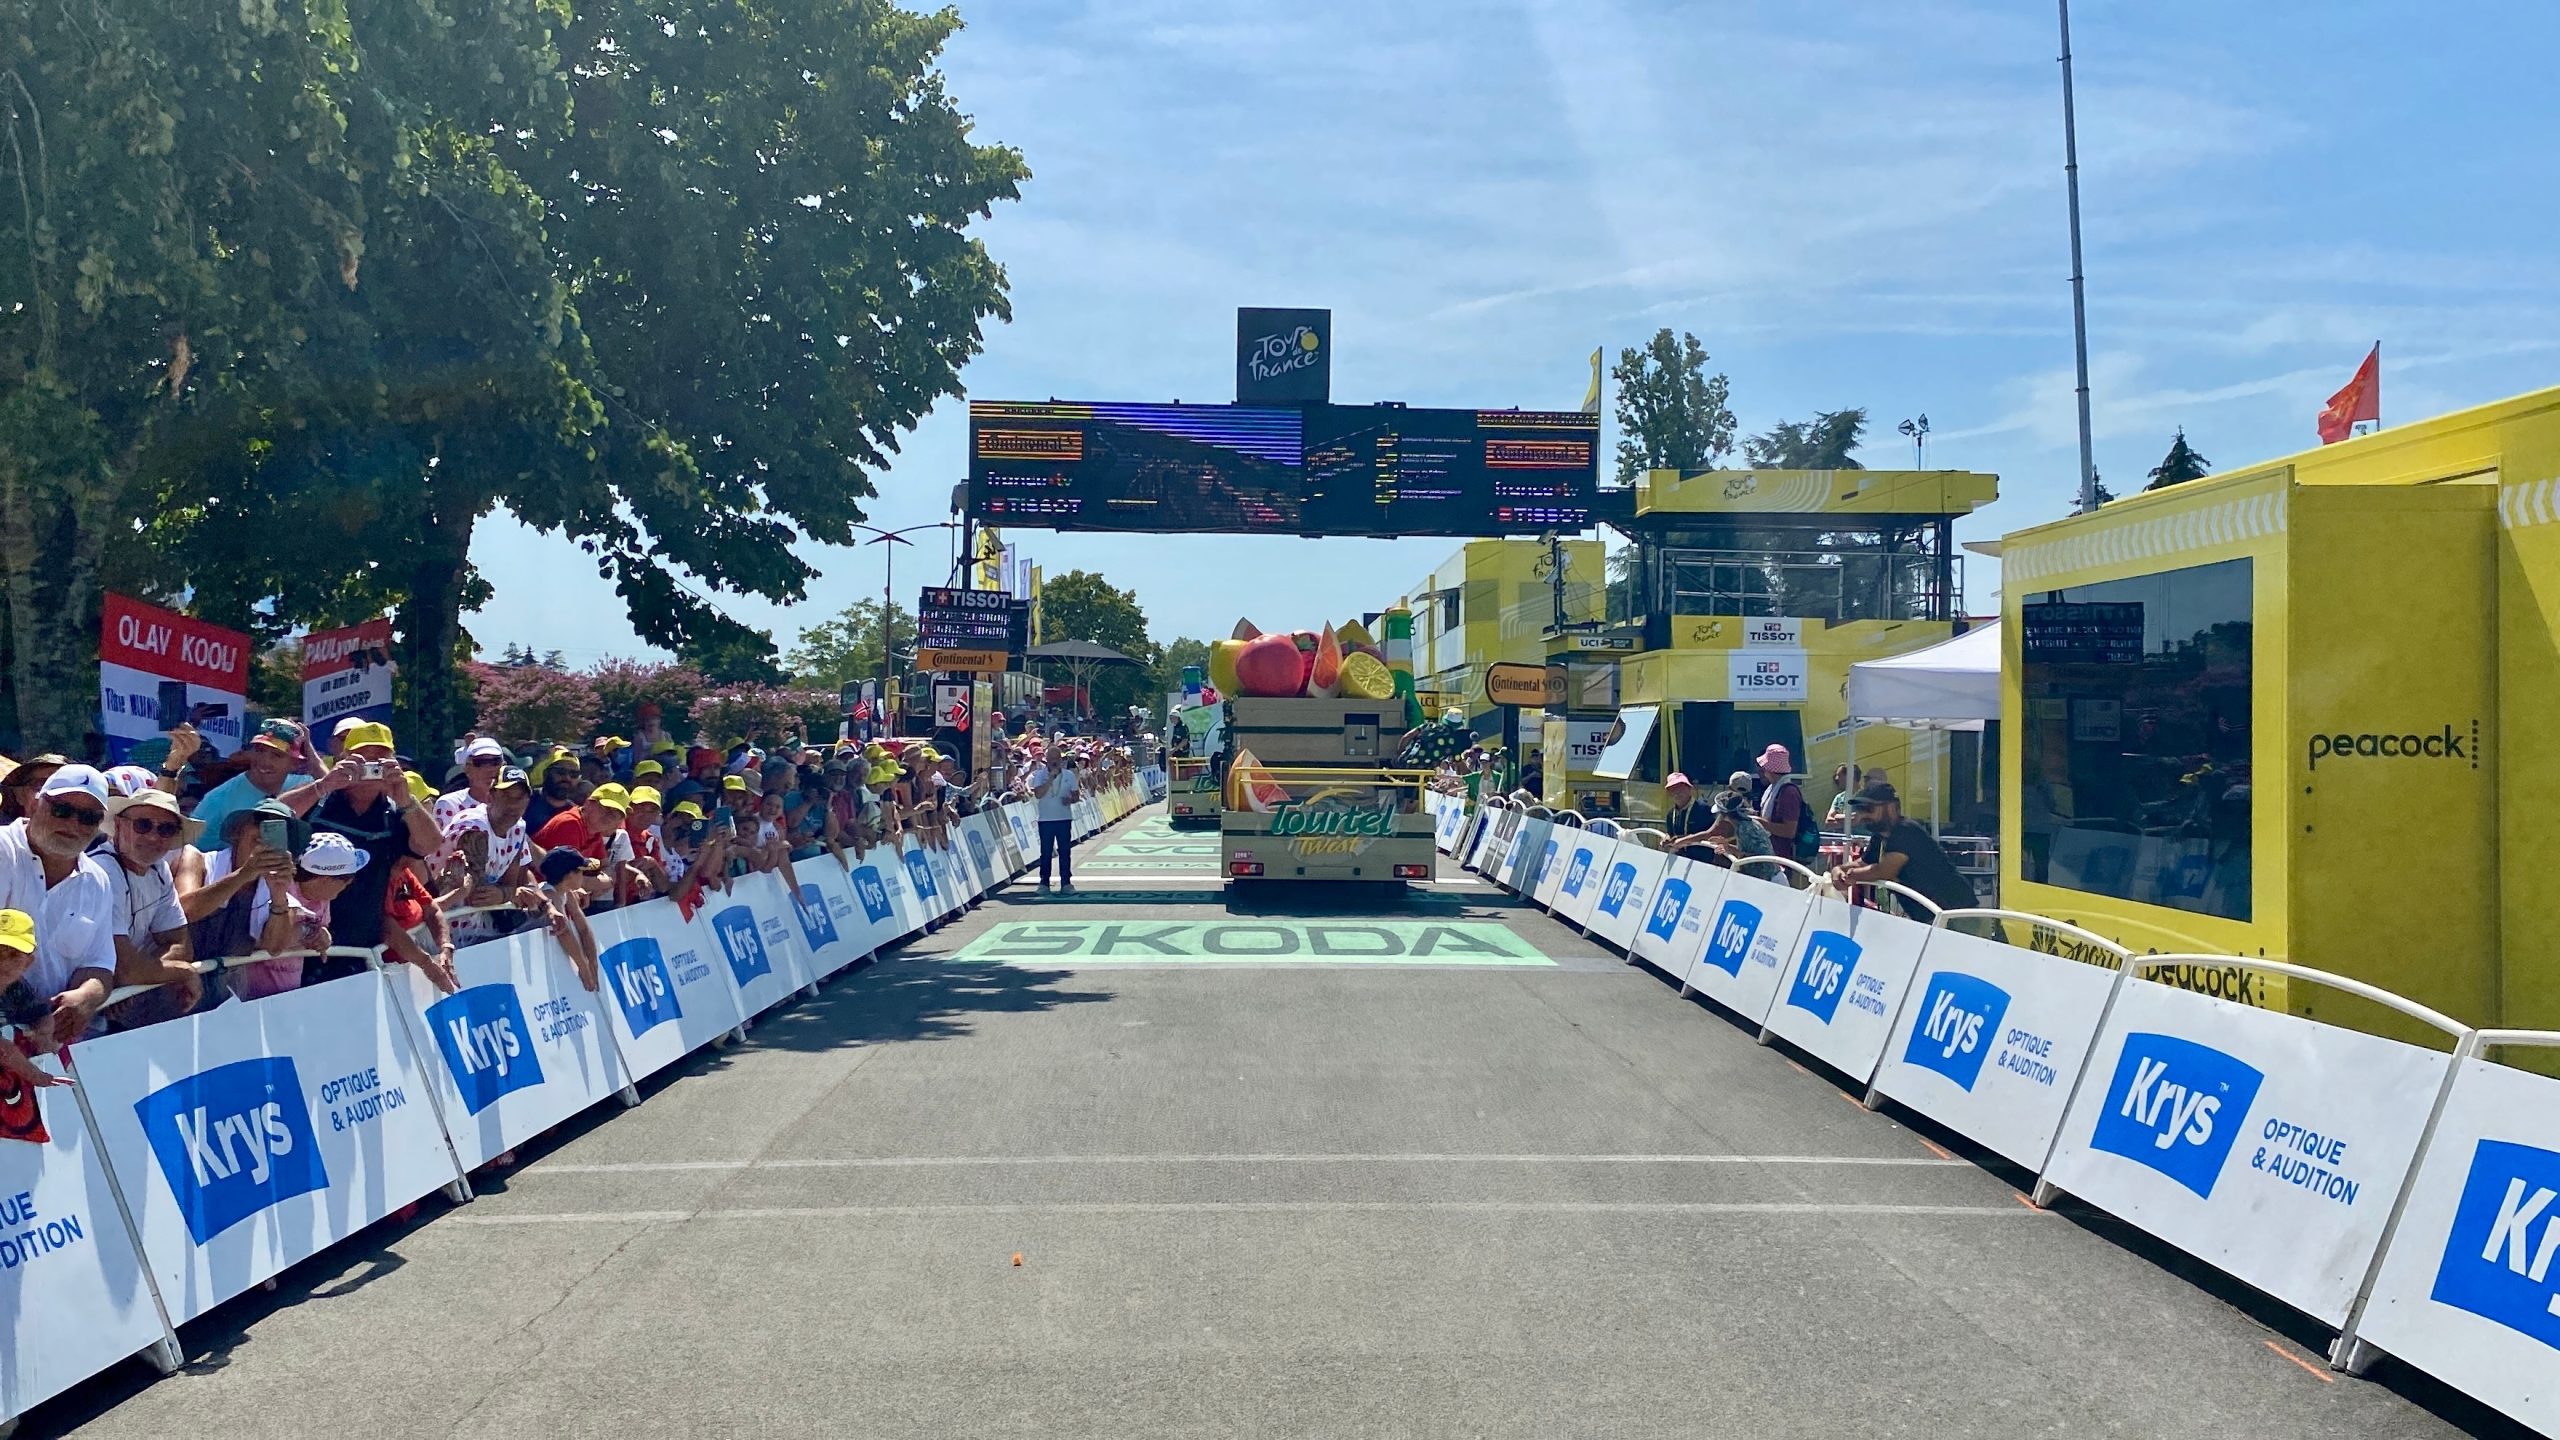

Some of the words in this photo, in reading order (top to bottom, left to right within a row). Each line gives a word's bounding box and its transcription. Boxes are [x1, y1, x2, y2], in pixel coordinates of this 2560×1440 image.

[950, 592, 1011, 609] TISSOT
[119, 615, 172, 656] OLAV
[1580, 639, 1599, 647] UCI
[1749, 632, 1795, 641] TISSOT
[932, 652, 986, 668] Continental
[1491, 675, 1540, 692] Continental
[1737, 675, 1799, 686] TISSOT
[2309, 724, 2466, 771] peacock
[1271, 799, 1396, 836] Tourtel
[1297, 836, 1363, 856] Twist
[858, 878, 884, 911] Krys
[1607, 871, 1627, 906] Krys
[1656, 889, 1681, 928] Krys
[723, 924, 758, 966] Krys
[1716, 912, 1749, 959] Krys
[615, 961, 665, 1011] Krys
[1802, 944, 1843, 1000] Krys
[1856, 973, 1885, 996] OPTIQUE
[533, 996, 571, 1022] OPTIQUE
[1856, 993, 1887, 1017] AUDITION
[1923, 989, 1984, 1059] Krys
[541, 1028, 551, 1042] &
[551, 1011, 590, 1039] AUDITION
[2007, 1028, 2053, 1058] OPTIQUE
[449, 1015, 520, 1077] Krys
[321, 1067, 381, 1105] OPTIQUE
[1998, 1050, 2008, 1068] &
[2007, 1054, 2057, 1087] AUDITION
[331, 1111, 343, 1132] &
[348, 1086, 407, 1127] AUDITION
[2120, 1056, 2222, 1150] Krys
[174, 1101, 293, 1188] Krys
[2263, 1118, 2347, 1166] OPTIQUE
[2251, 1146, 2267, 1171] &
[2268, 1154, 2360, 1206] AUDITION
[0, 1191, 37, 1229] UE
[0, 1214, 83, 1269] DITION
